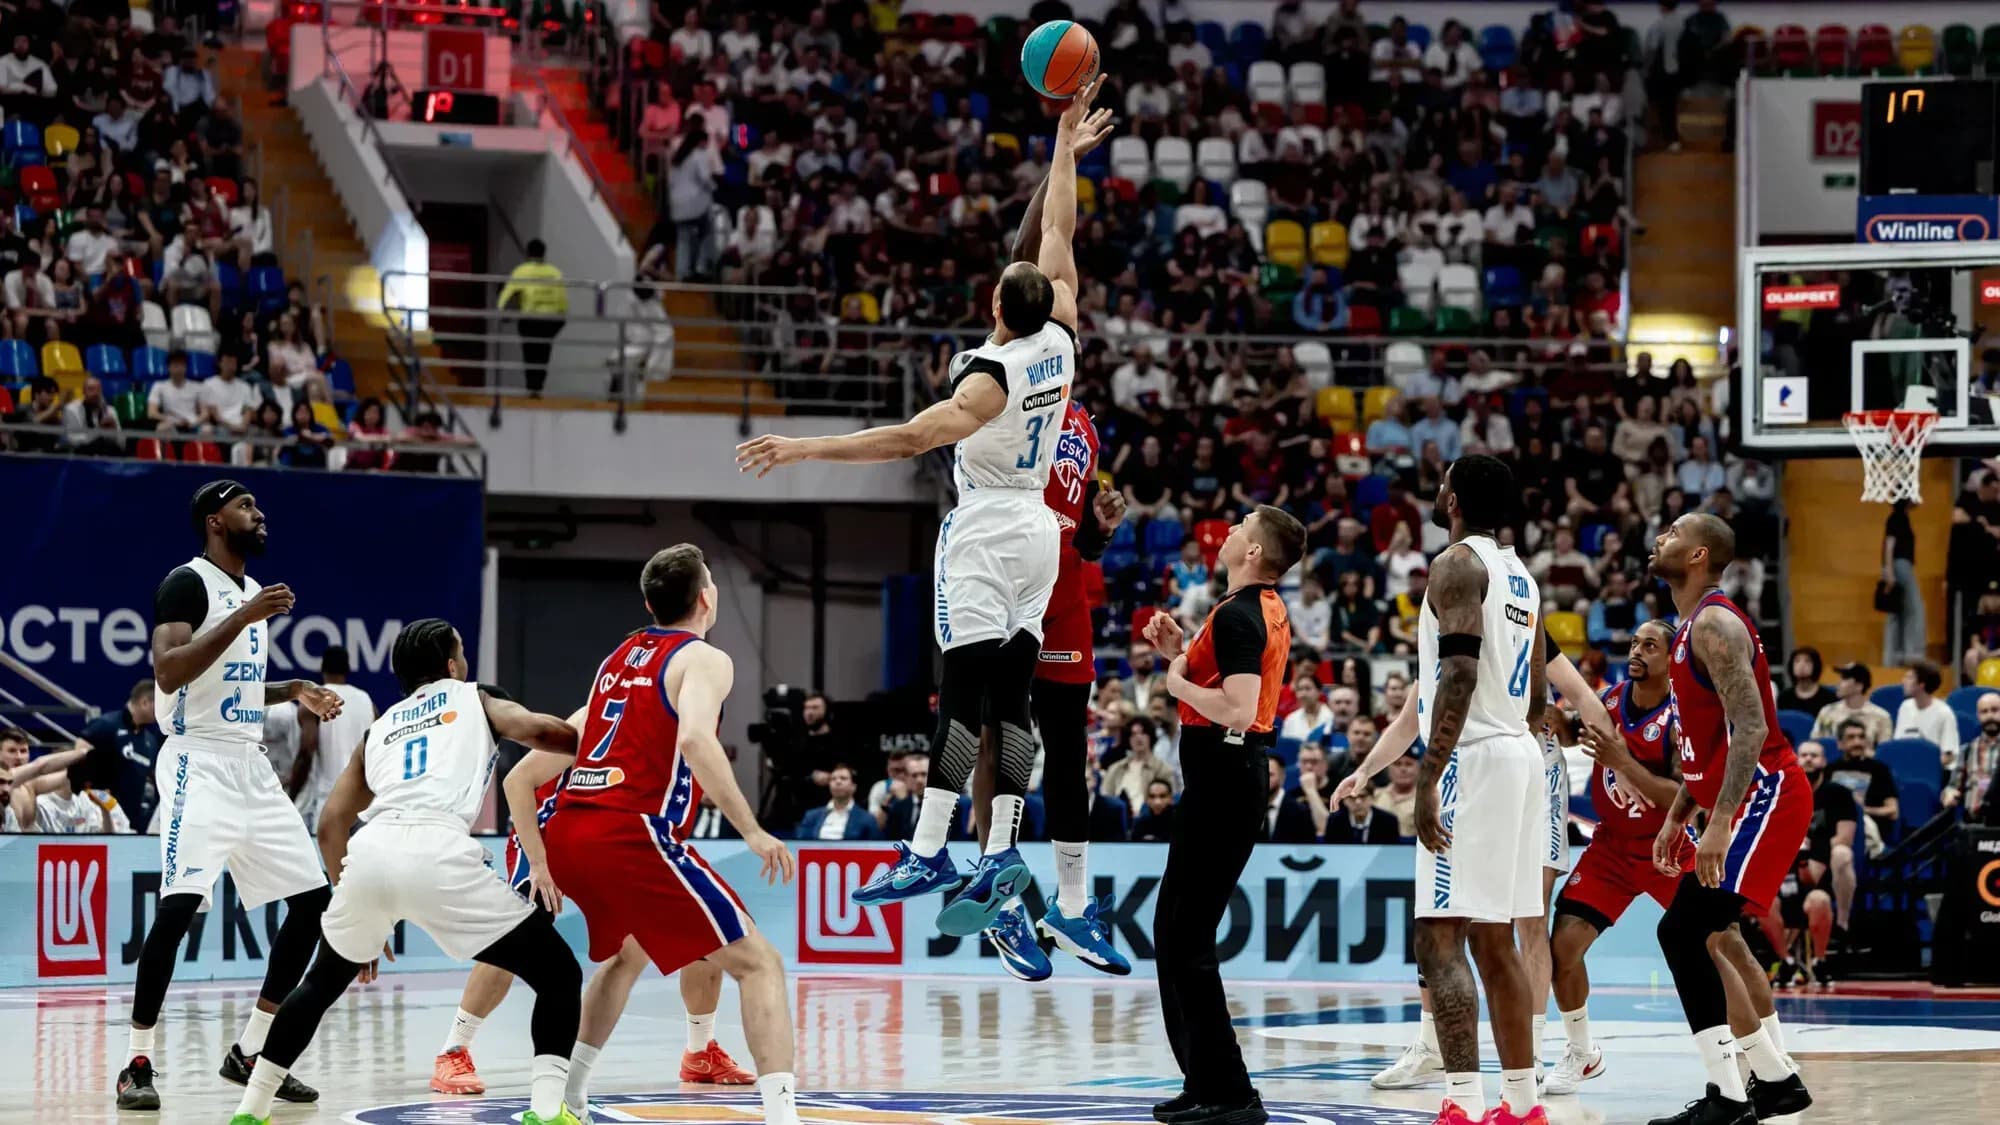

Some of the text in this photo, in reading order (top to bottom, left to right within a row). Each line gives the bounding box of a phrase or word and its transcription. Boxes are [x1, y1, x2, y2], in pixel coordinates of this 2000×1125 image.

[439, 51, 473, 85] D1
[1877, 222, 1955, 240] Winline
[1765, 290, 1838, 304] OLIMPBET
[1026, 355, 1063, 386] HUNTER
[1024, 391, 1060, 409] Winline
[1060, 439, 1088, 465] CSKA
[249, 626, 259, 655] 5
[393, 692, 447, 725] FRAZIER
[387, 718, 438, 743] Winline
[587, 698, 628, 761] 7
[403, 736, 428, 780] 0
